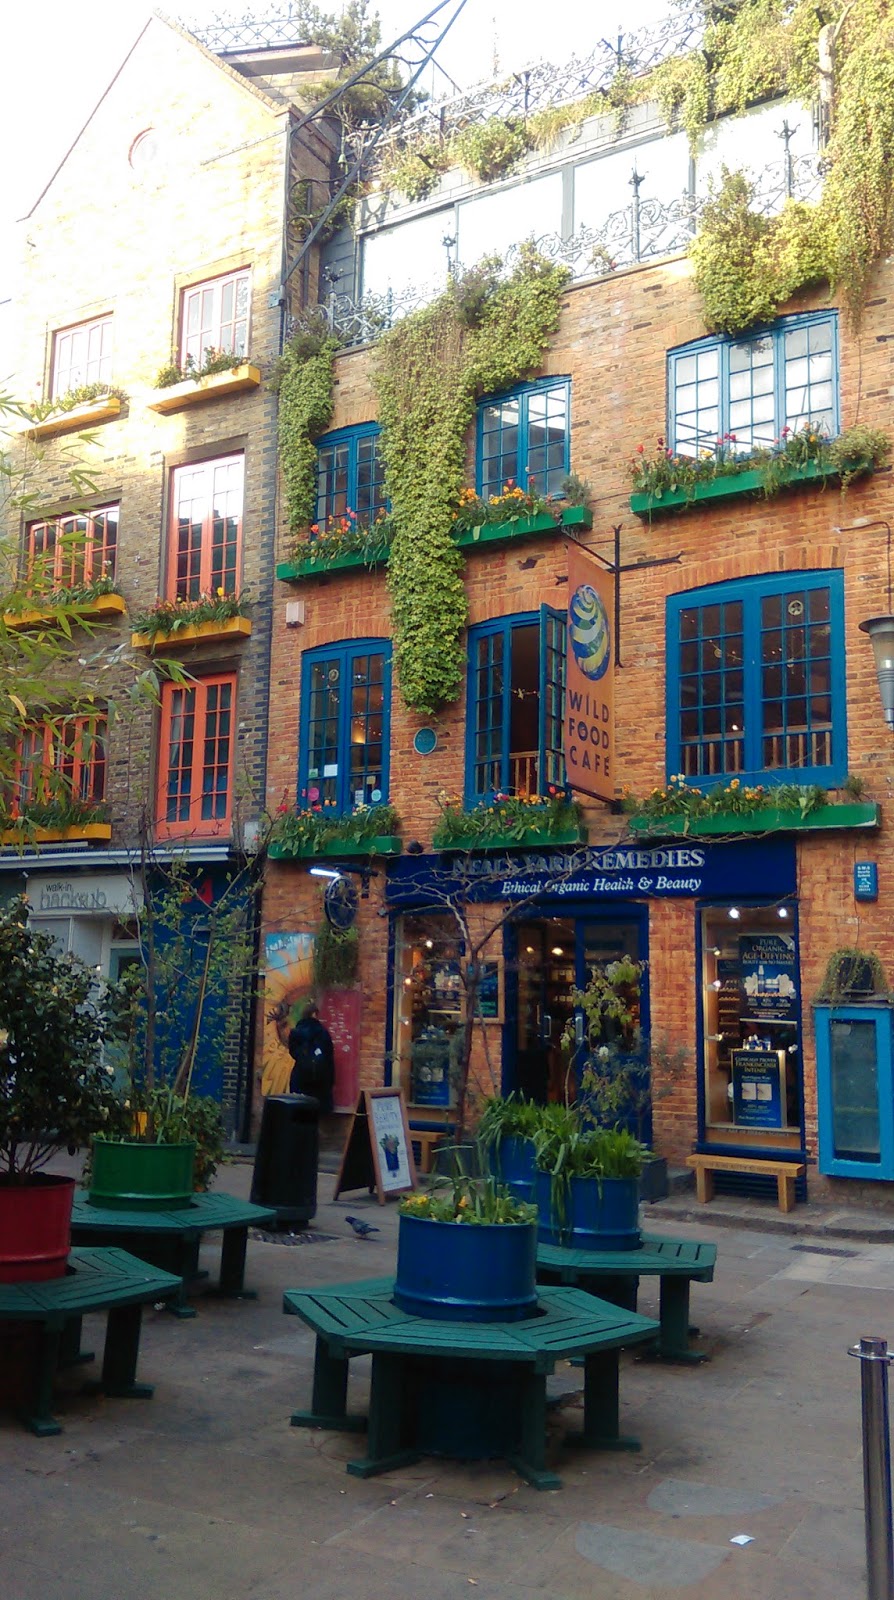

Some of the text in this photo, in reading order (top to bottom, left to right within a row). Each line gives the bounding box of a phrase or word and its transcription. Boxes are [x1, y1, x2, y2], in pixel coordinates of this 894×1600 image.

[569, 689, 609, 723] WILD
[569, 717, 609, 749] FOOD
[569, 745, 610, 777] CAFÉ
[584, 849, 704, 871] REMEDIES
[45, 881, 73, 893] walk-in
[502, 881, 541, 894] Ethical
[593, 877, 634, 892] Health
[638, 876, 653, 890] &
[655, 875, 702, 892] Beauty
[742, 952, 795, 960] AGE-DEFYING
